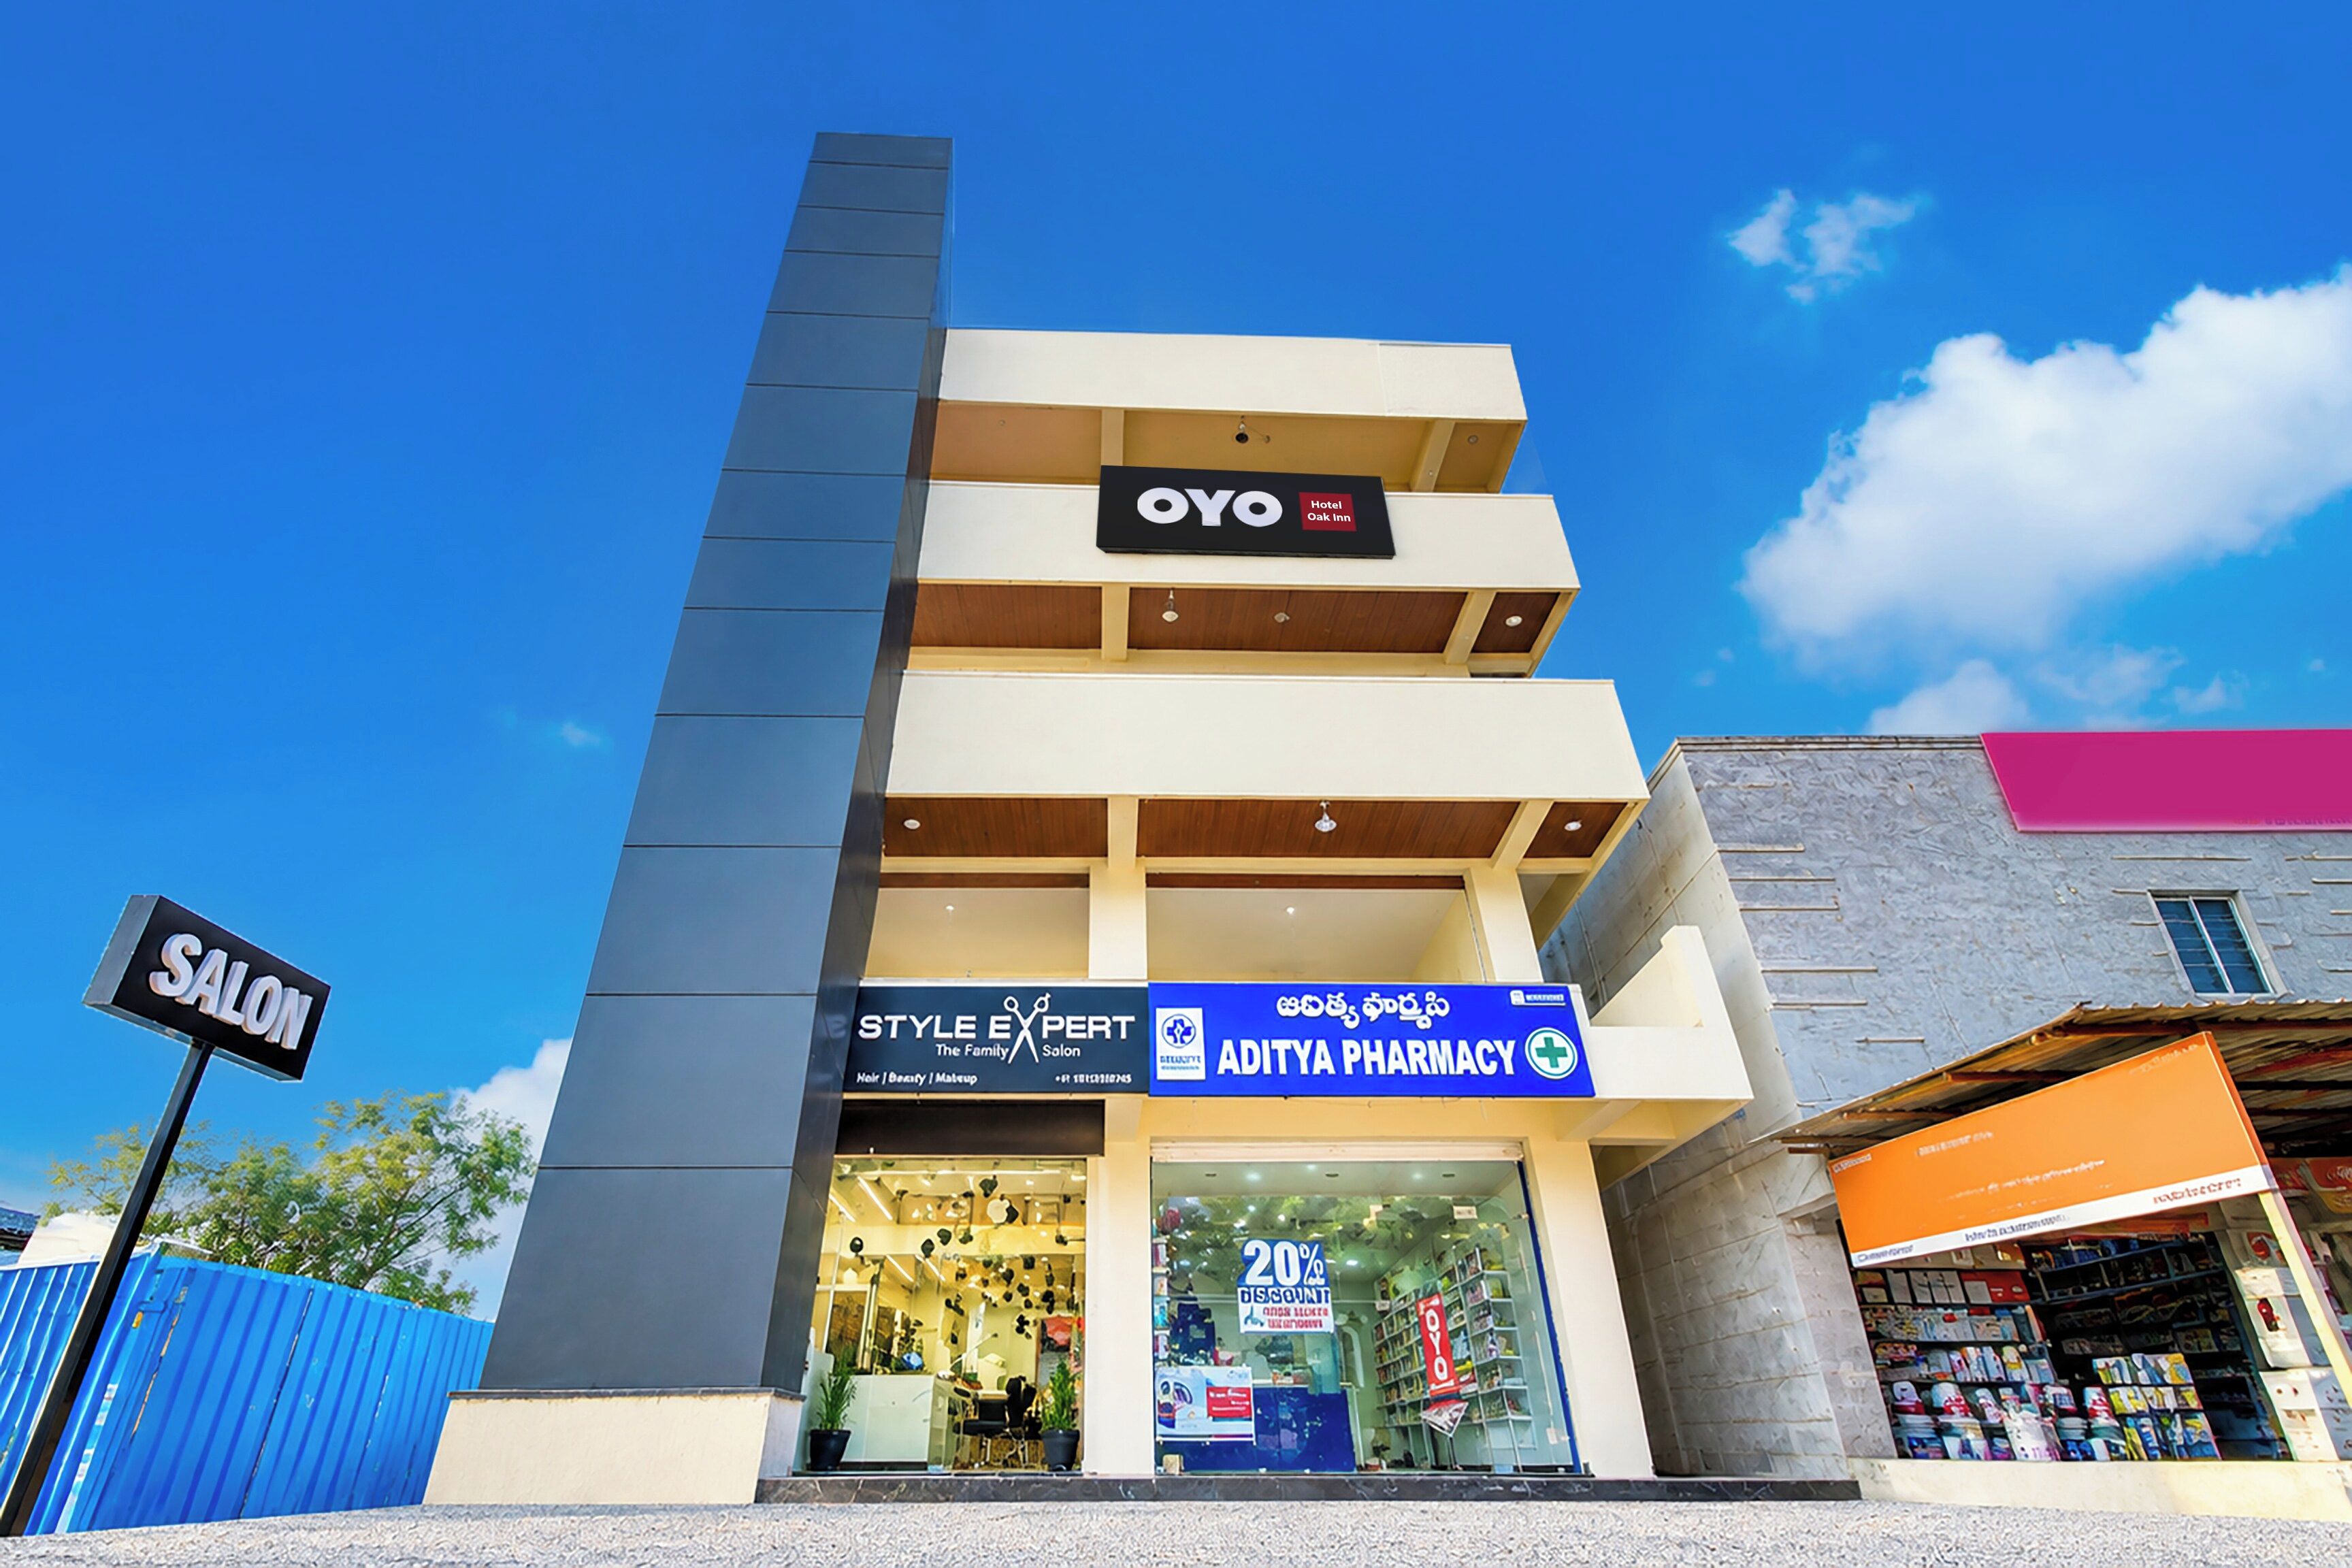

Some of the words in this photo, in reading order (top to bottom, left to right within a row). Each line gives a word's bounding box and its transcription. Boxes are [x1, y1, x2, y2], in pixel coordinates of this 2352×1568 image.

[1137, 487, 1283, 527] OYO
[1307, 512, 1331, 522] Oak
[1333, 513, 1352, 523] Inn
[1311, 500, 1343, 510] Hotel
[148, 933, 314, 1050] SALON
[858, 1015, 977, 1040] STYLE
[936, 1044, 960, 1057] The
[964, 1043, 1009, 1061] Family
[1042, 1044, 1081, 1058] Salon
[1217, 1039, 1336, 1076] ADITYA
[1343, 1039, 1516, 1076] PHARMACY
[1243, 1239, 1325, 1286] 20%
[1425, 1309, 1448, 1381] OYO
